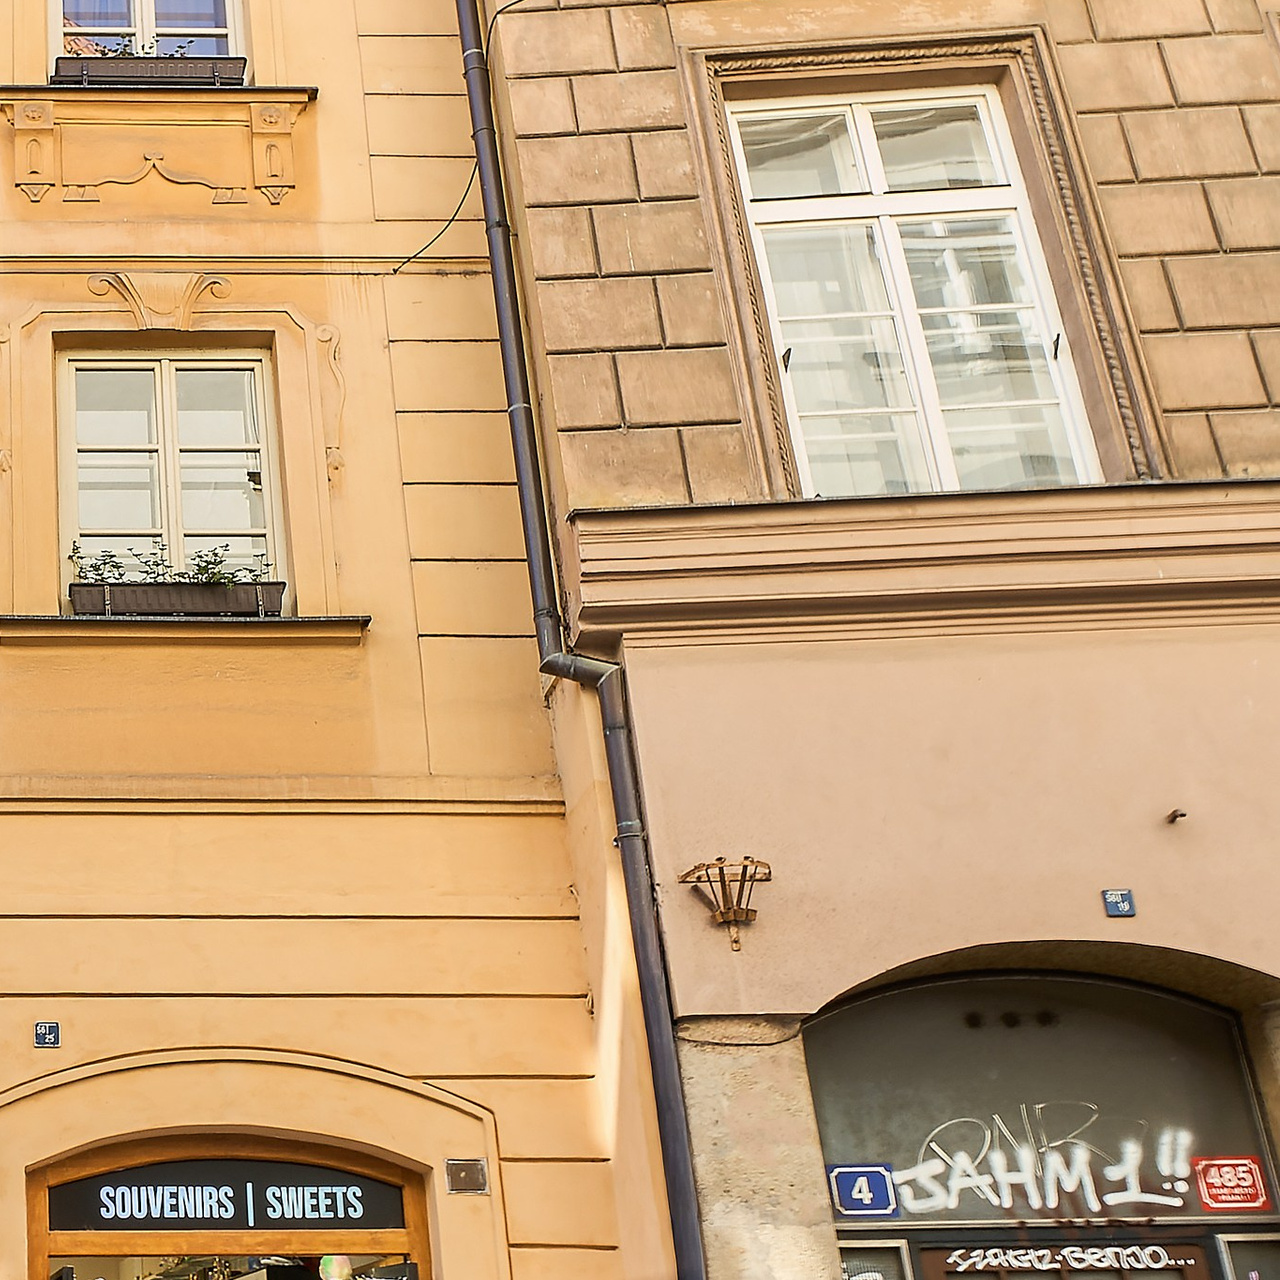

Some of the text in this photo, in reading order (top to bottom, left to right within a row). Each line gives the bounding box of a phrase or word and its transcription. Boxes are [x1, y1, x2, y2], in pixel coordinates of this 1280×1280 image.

[851, 1176, 874, 1205] 4
[1205, 1165, 1254, 1187] 485
[99, 1185, 364, 1219] SOUVENIRS SWEETS
